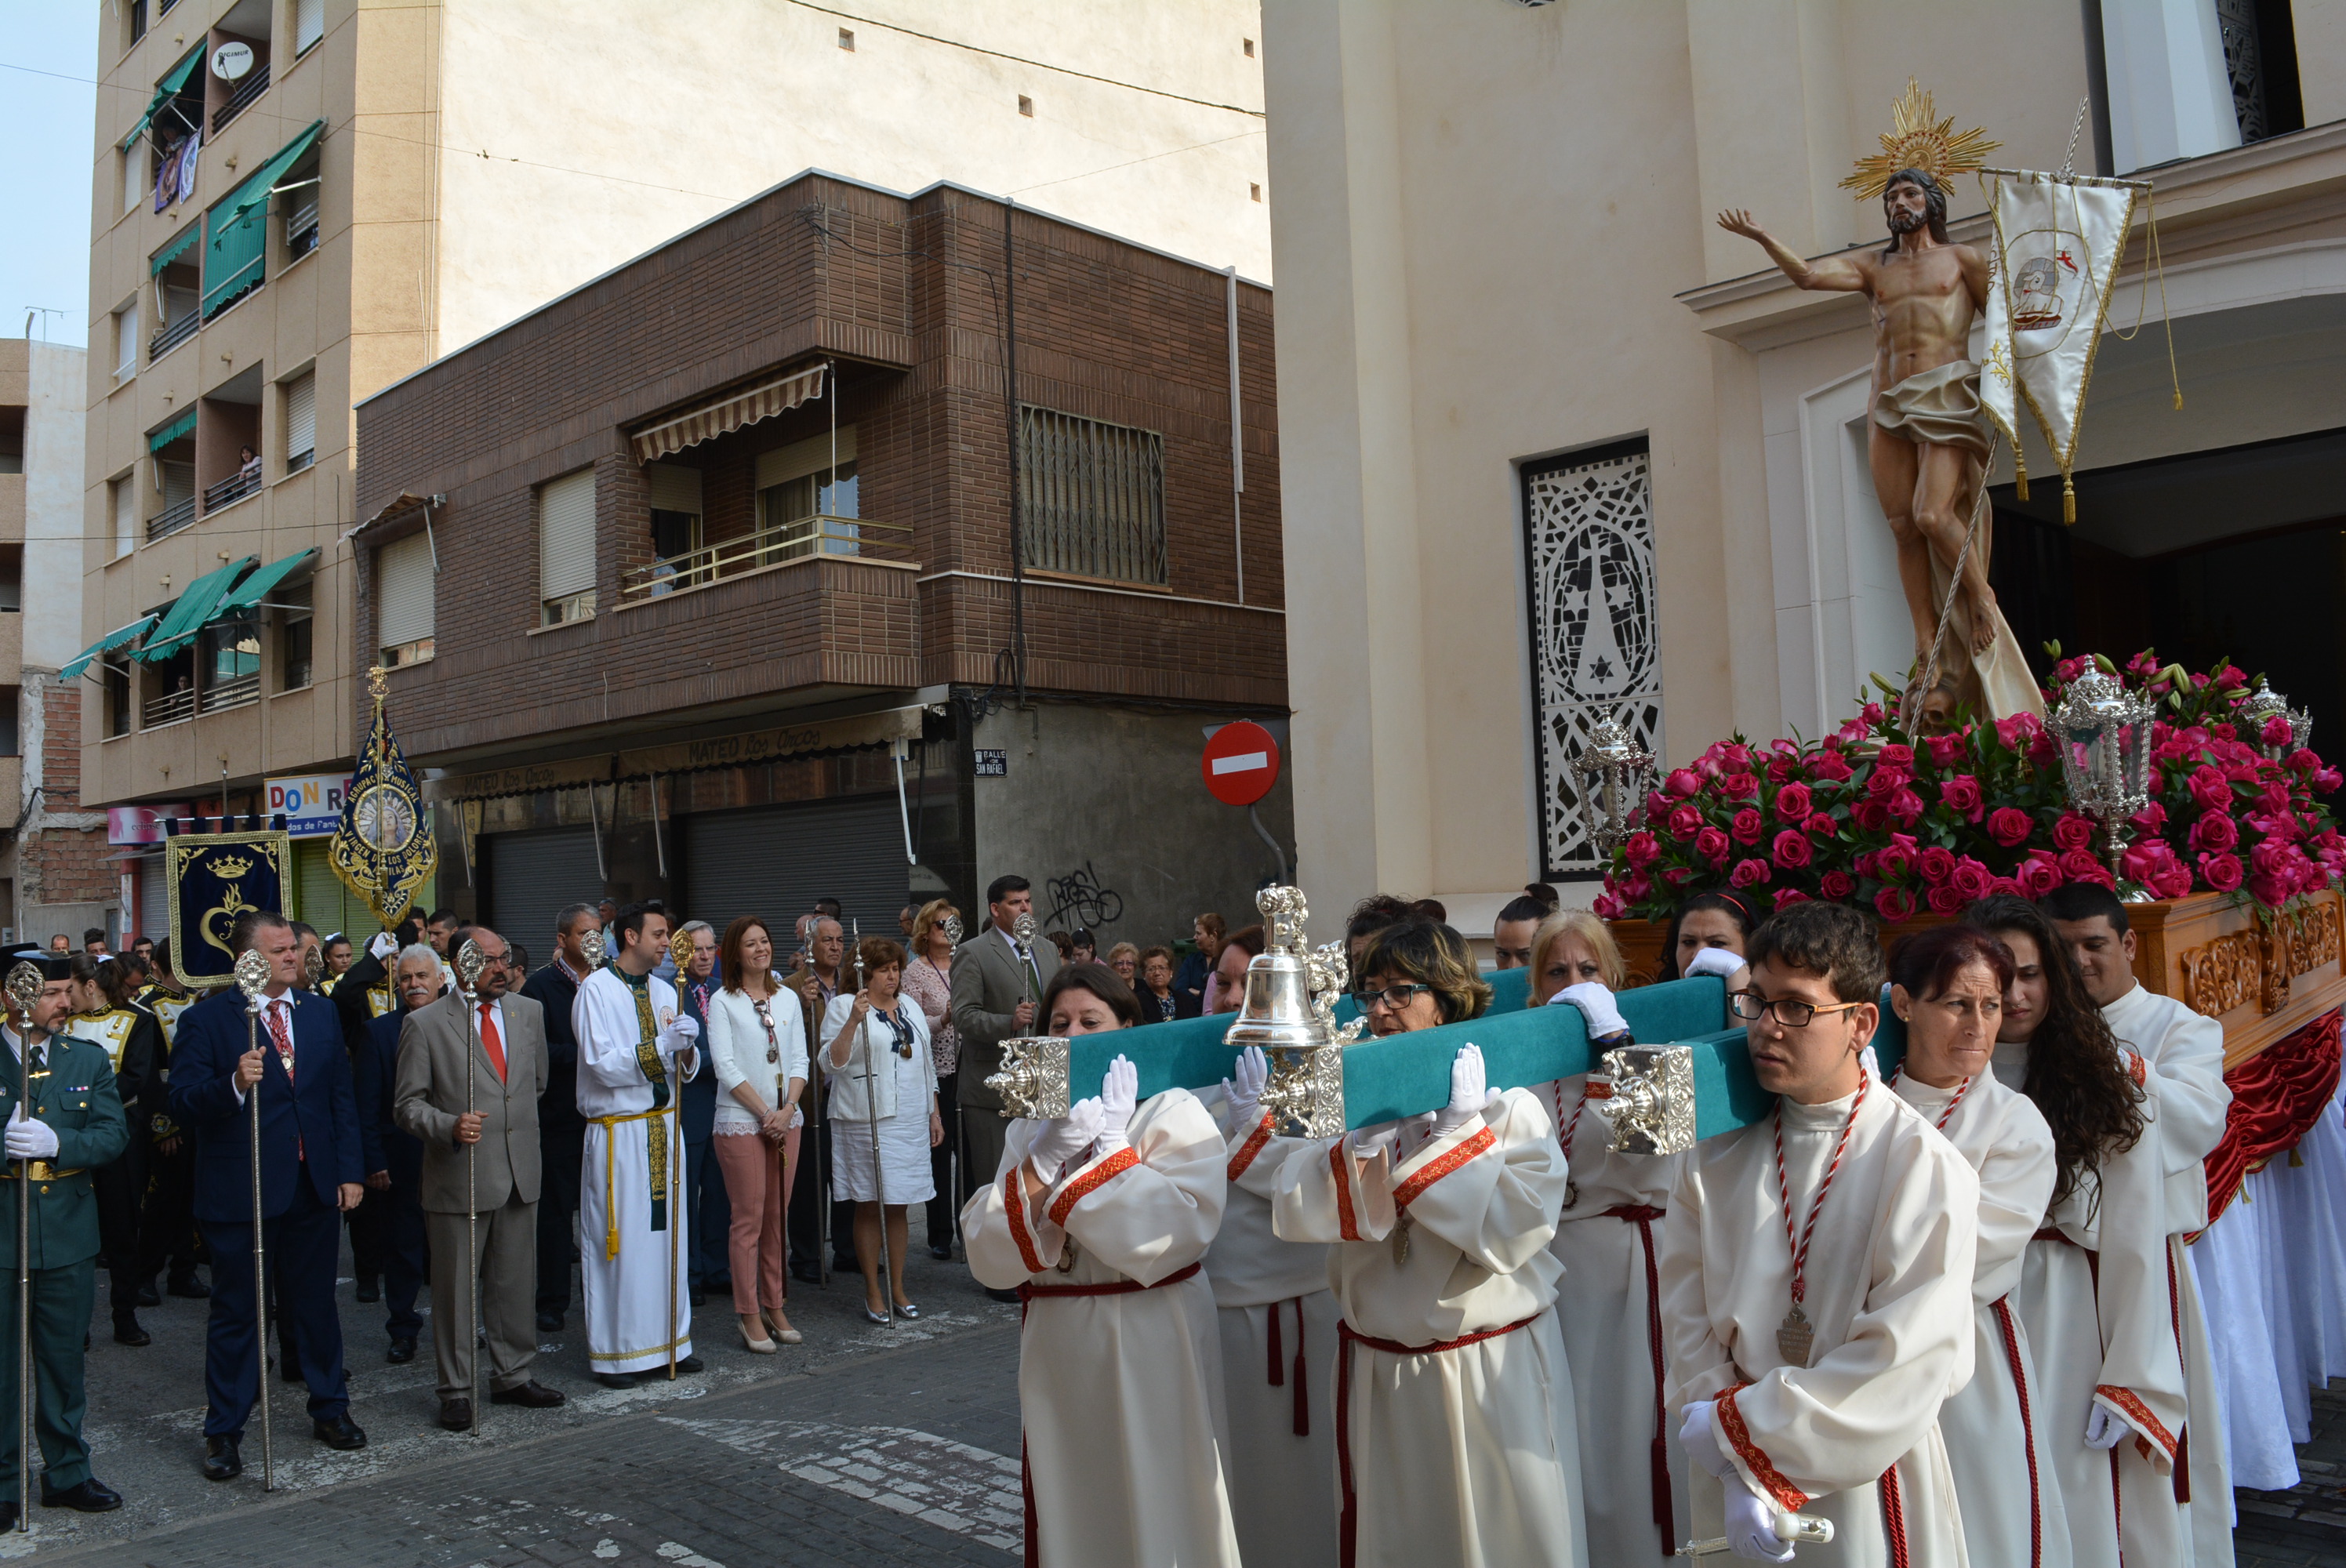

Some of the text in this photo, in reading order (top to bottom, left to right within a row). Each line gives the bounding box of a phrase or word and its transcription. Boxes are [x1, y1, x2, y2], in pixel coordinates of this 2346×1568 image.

[689, 737, 739, 763] MATEO
[745, 734, 768, 756] Los
[976, 764, 1004, 775] SAN RAFAEL
[348, 774, 420, 804] AGRUPACIN MUSICAL
[464, 772, 498, 793] MATEO
[503, 771, 520, 789] Los
[270, 782, 319, 812] DON
[131, 821, 161, 834] eclipse
[304, 822, 315, 830] de
[345, 830, 371, 858] VIRGEN
[387, 855, 401, 865] LOS
[403, 829, 426, 859] DOLORES
[372, 864, 405, 876] AILAS
